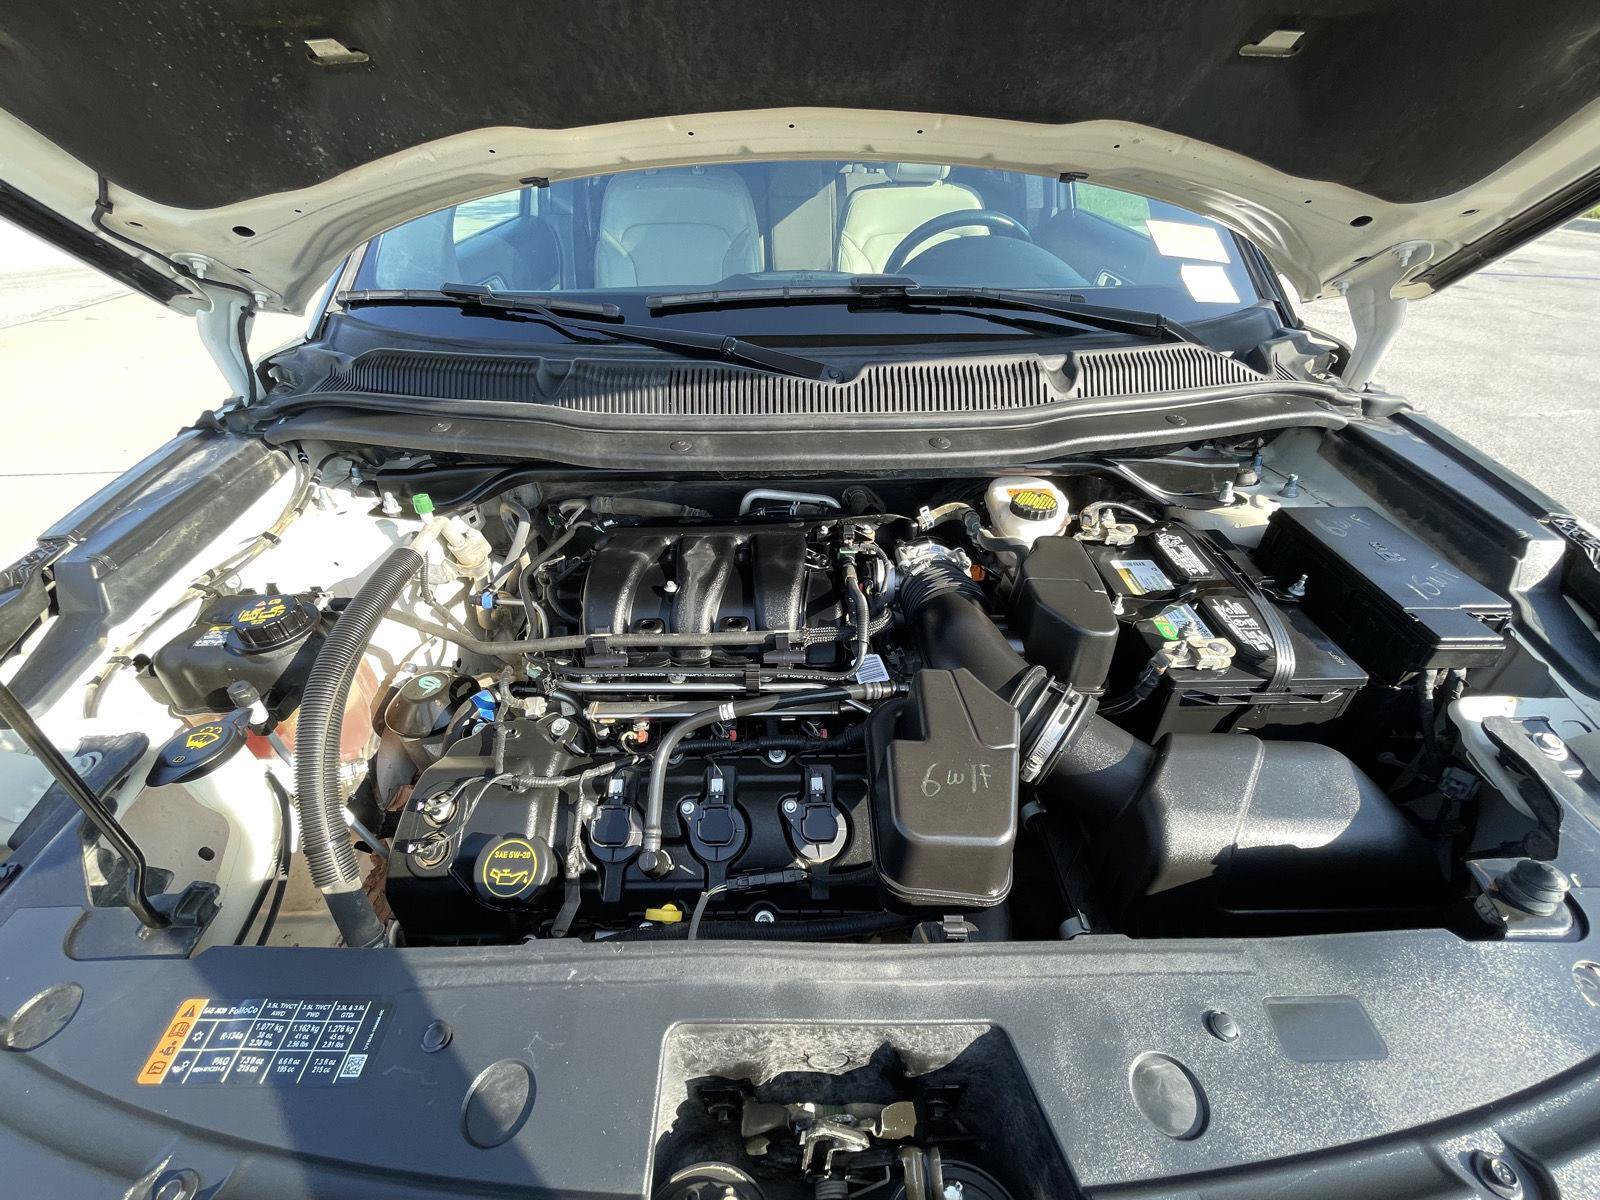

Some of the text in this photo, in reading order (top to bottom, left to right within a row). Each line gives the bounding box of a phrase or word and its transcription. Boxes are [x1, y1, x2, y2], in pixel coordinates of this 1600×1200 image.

[494, 851, 531, 859] SAE 5W-20
[228, 1006, 259, 1015] FoMoCo
[274, 1023, 285, 1033] kg
[292, 1024, 320, 1034] 1.162 kg
[345, 1025, 355, 1034] kg
[220, 1032, 244, 1040] R-134a
